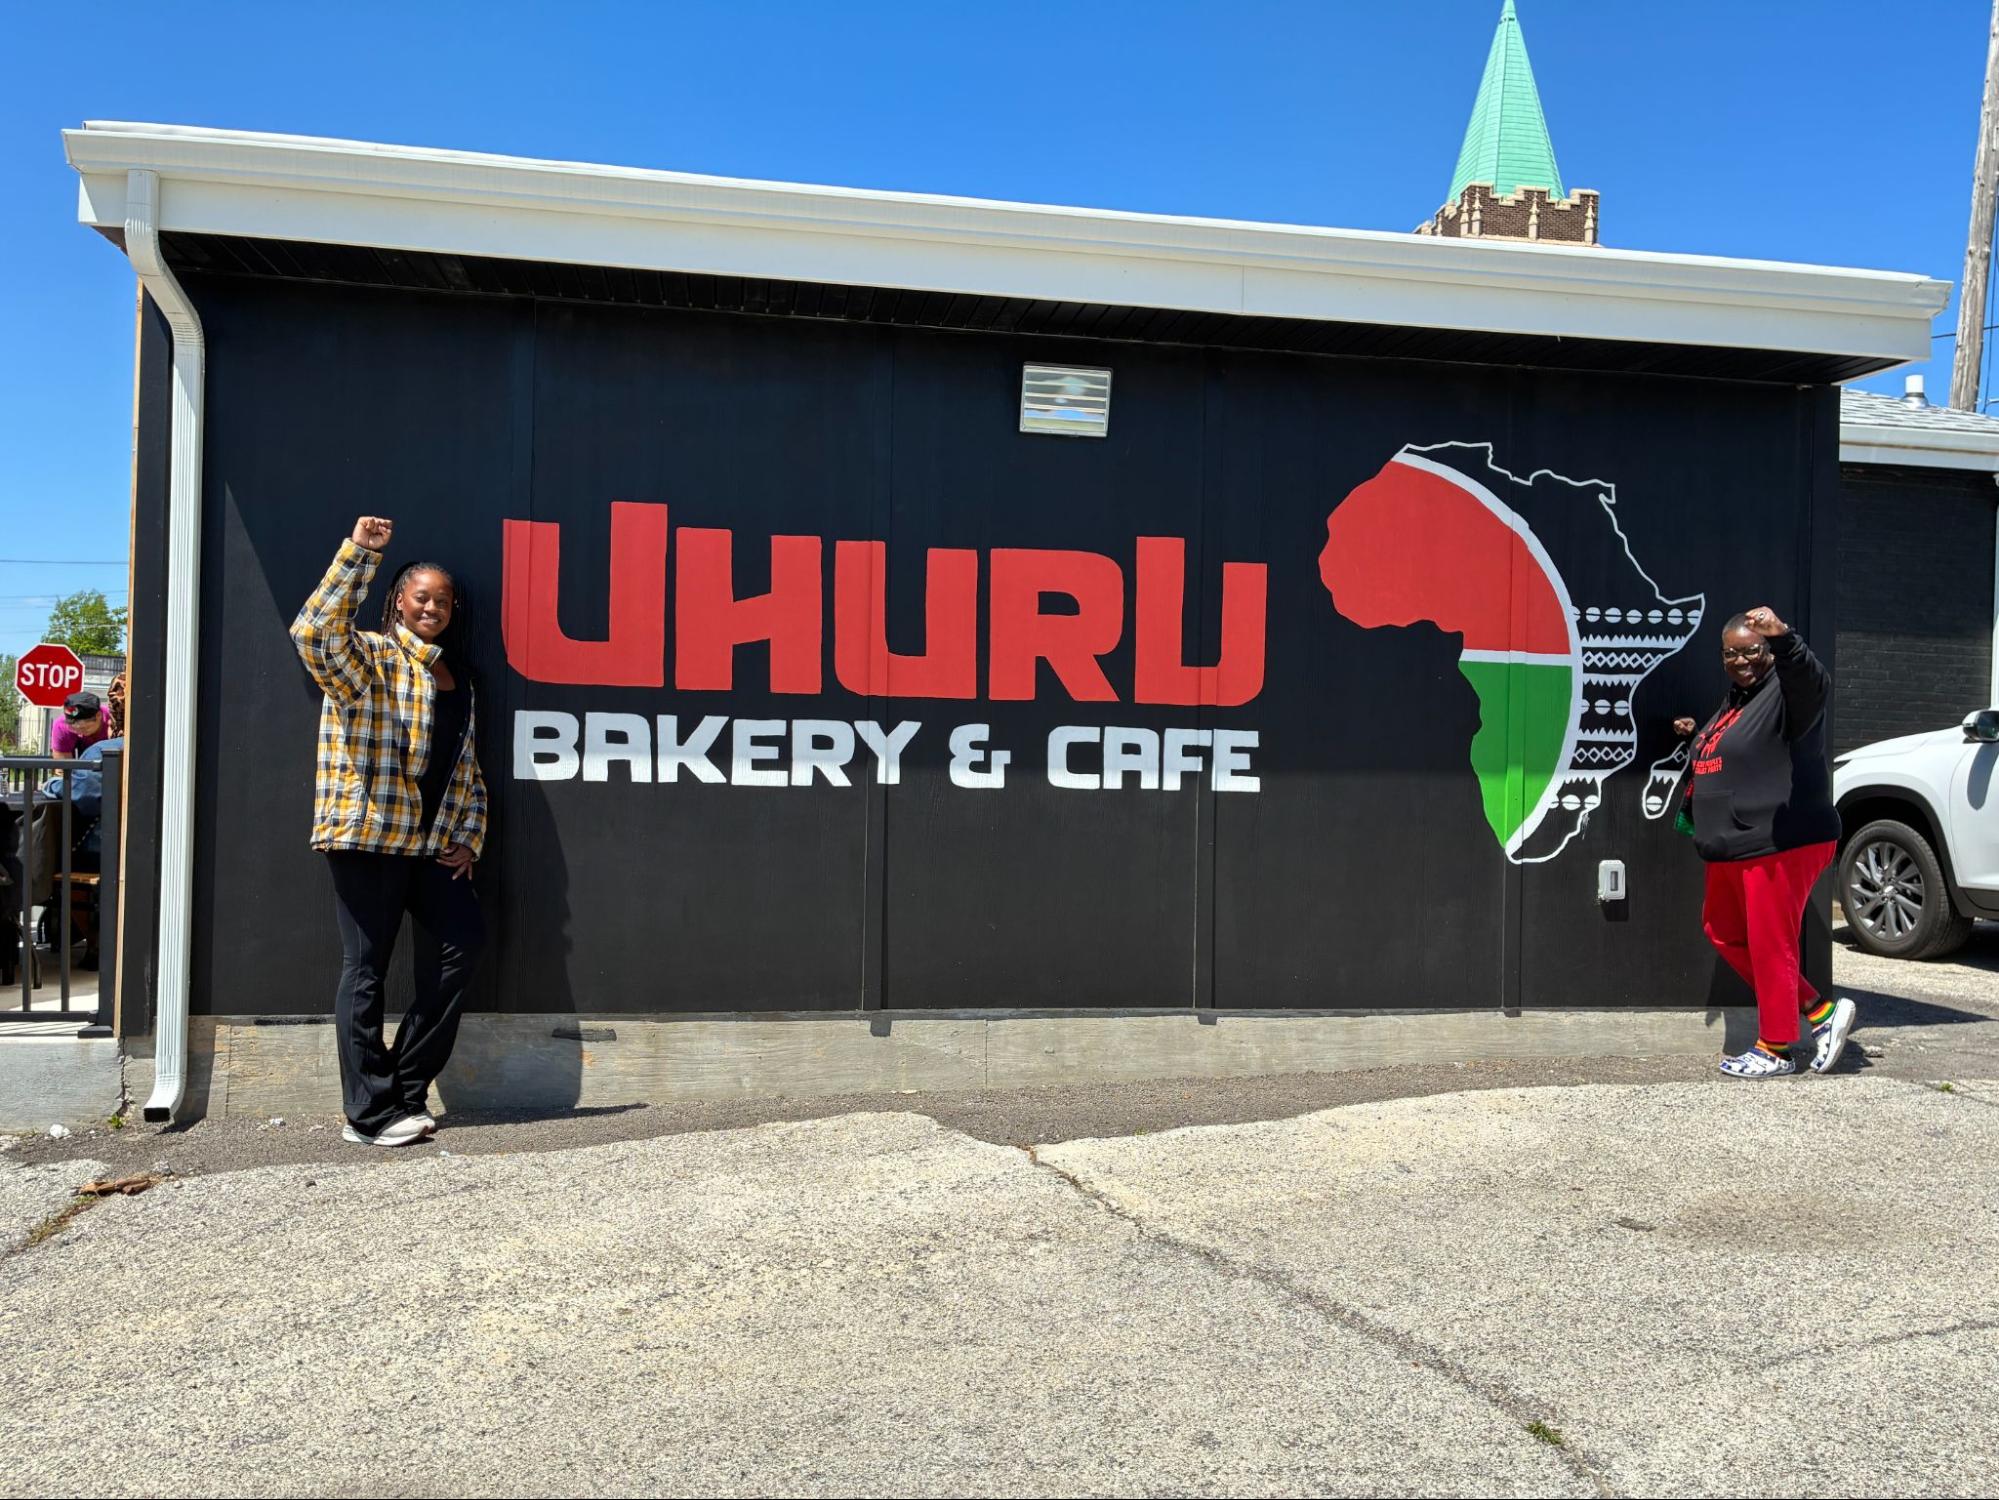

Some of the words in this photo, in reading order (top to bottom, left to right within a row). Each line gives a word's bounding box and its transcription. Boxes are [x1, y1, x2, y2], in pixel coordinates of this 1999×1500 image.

[502, 501, 1268, 707] UHURU
[20, 663, 79, 688] STOP
[513, 710, 921, 787] BAKERY
[949, 723, 1011, 789] &
[1047, 725, 1261, 793] CAFE
